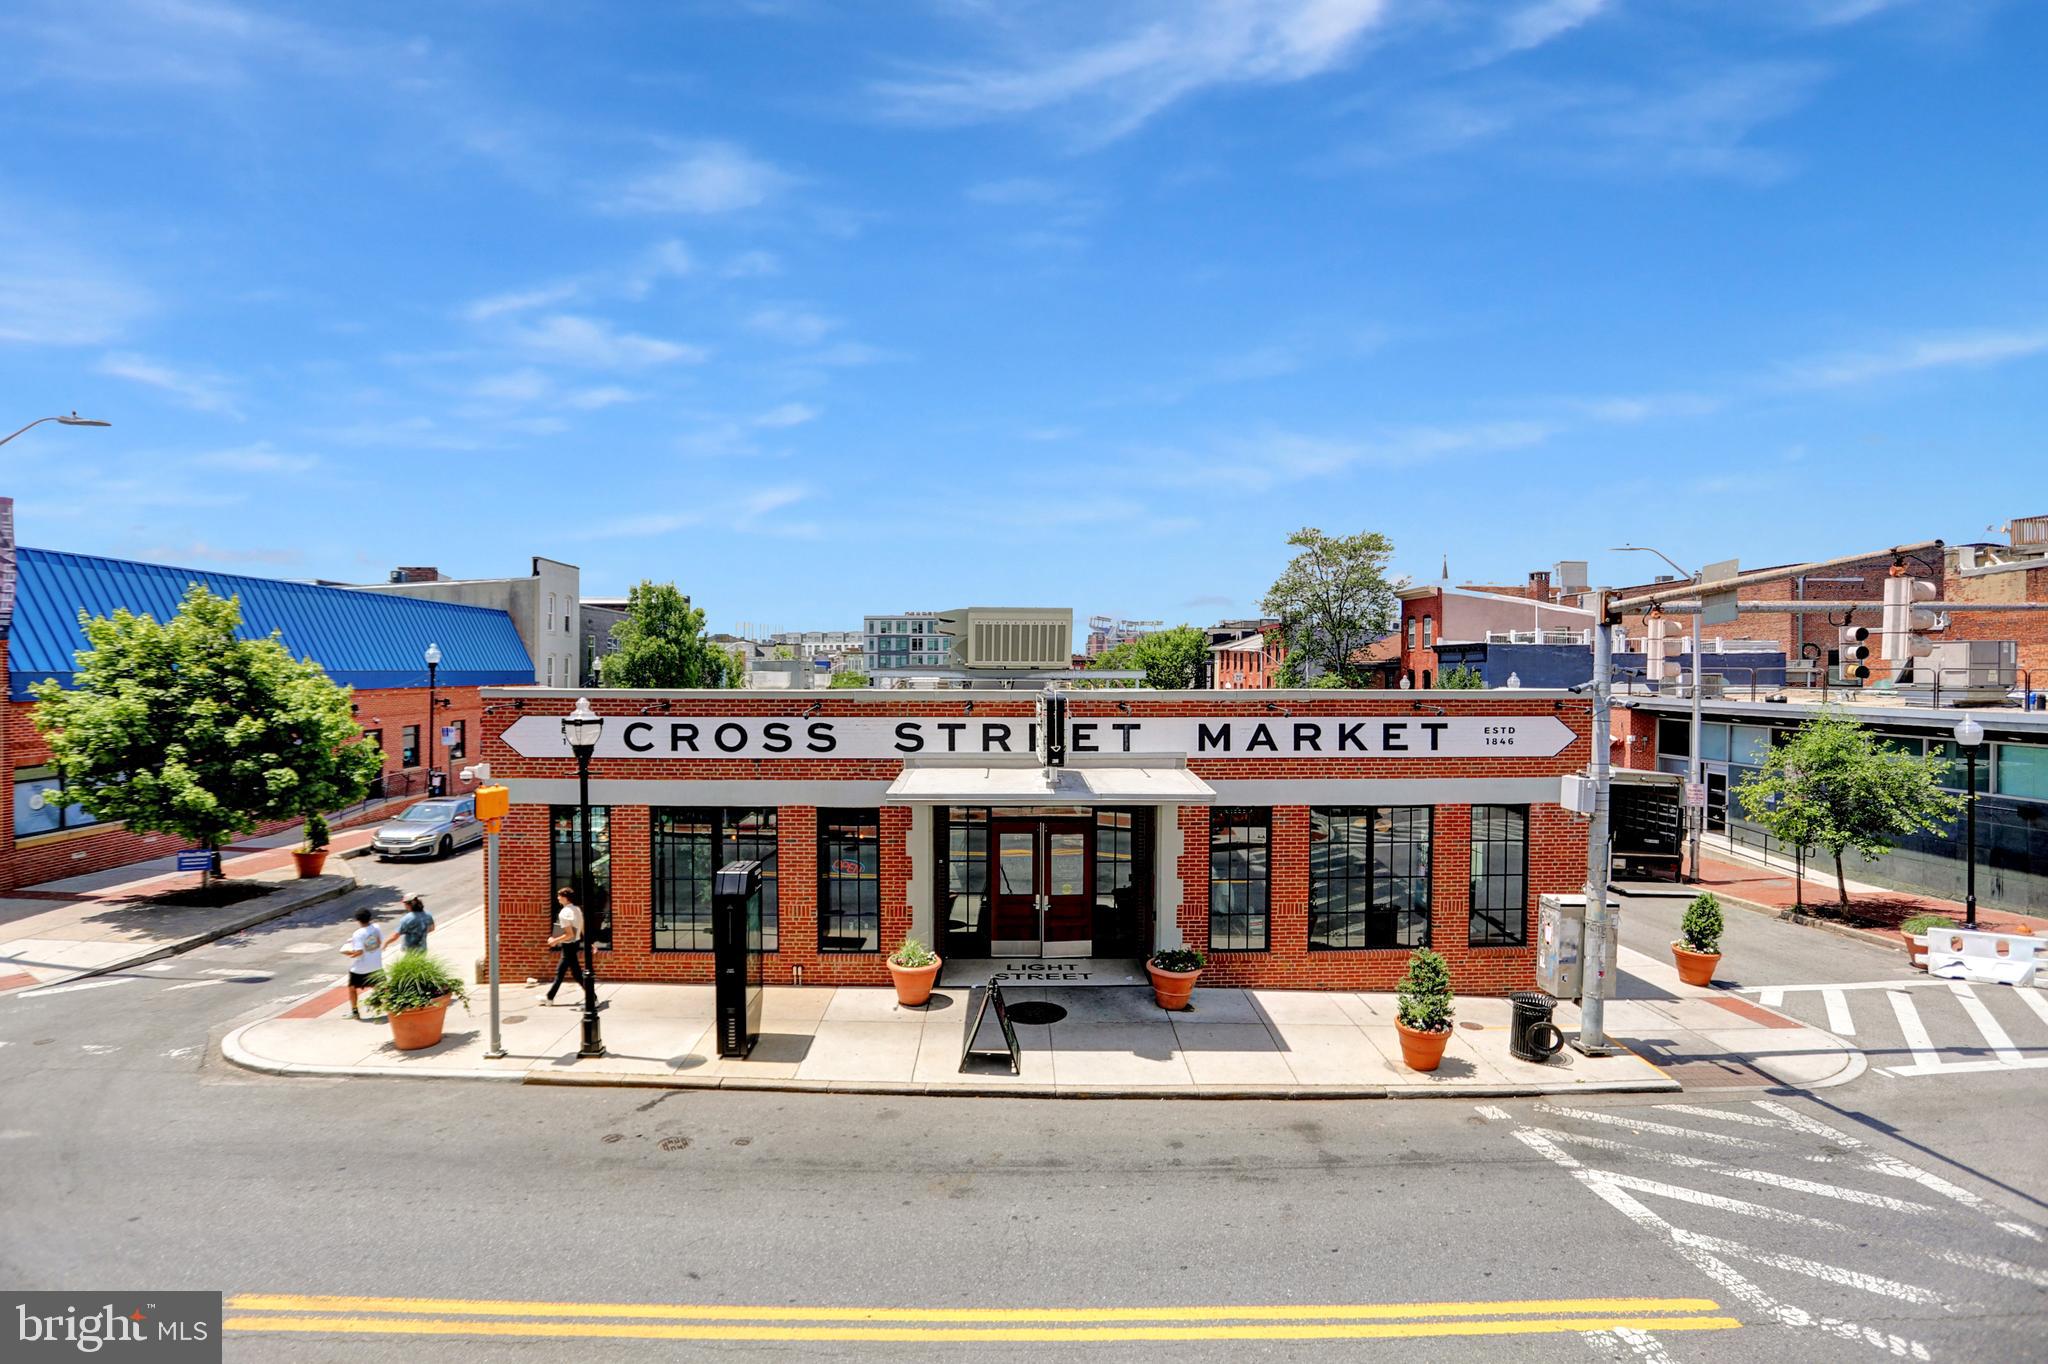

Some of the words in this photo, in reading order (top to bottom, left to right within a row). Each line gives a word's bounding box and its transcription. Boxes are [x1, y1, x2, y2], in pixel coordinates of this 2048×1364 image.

[1484, 726, 1516, 735] ESTD
[623, 721, 837, 753] CROSS
[894, 721, 1142, 753] STRET
[1198, 722, 1449, 752] MARKET
[1485, 737, 1514, 746] 1846
[1006, 963, 1079, 971] LIGHT
[995, 973, 1094, 981] STREET
